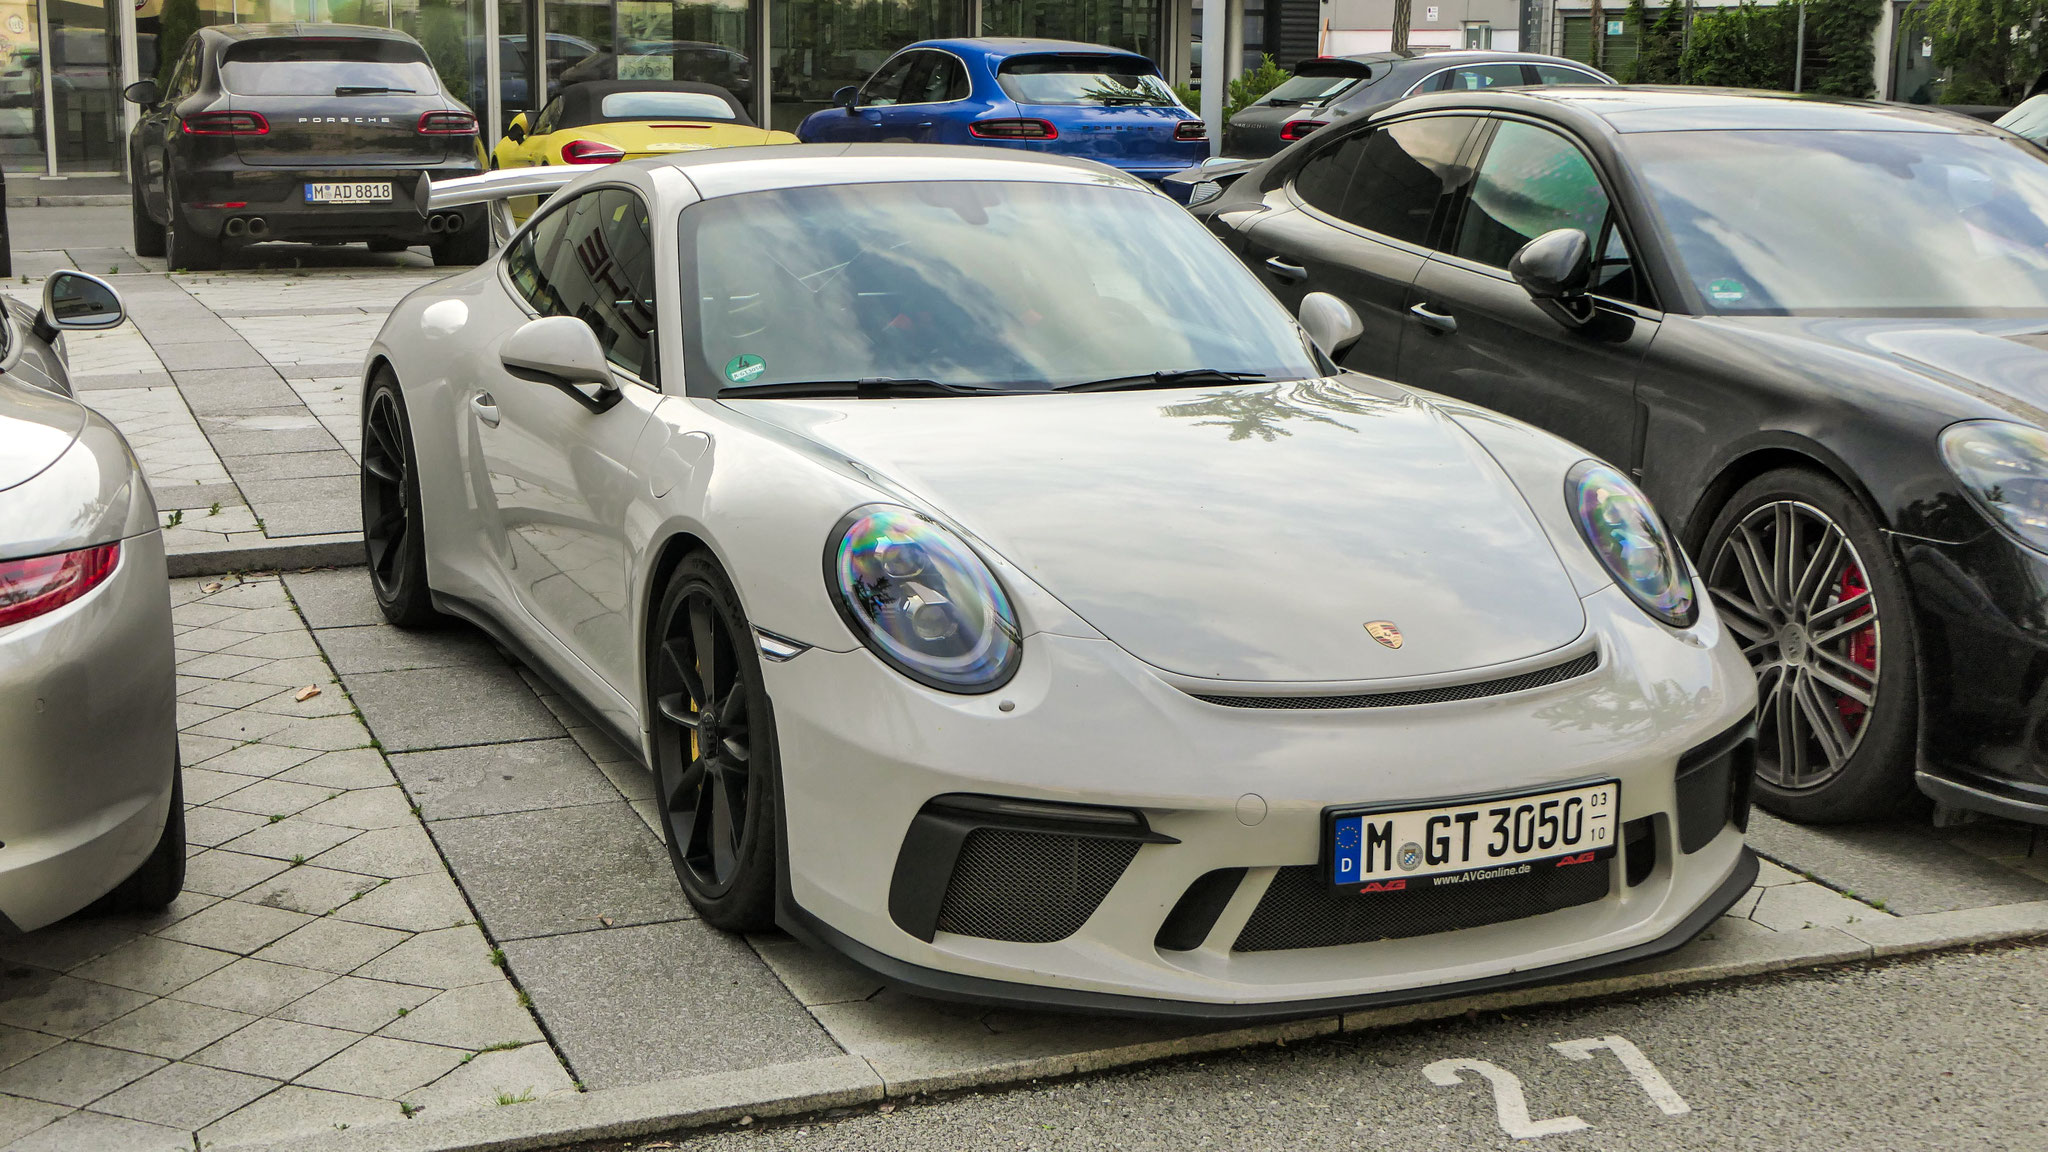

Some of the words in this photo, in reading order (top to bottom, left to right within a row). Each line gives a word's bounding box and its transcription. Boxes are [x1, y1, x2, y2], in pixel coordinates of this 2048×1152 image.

[314, 185, 324, 199] M
[334, 185, 352, 199] AD
[355, 184, 390, 198] 8818
[1591, 792, 1607, 807] 03
[1341, 857, 1352, 873] D
[1366, 820, 1393, 874] M
[1425, 811, 1479, 866] GT
[1488, 796, 1583, 858] 3050
[1591, 826, 1605, 841] 10
[1555, 851, 1595, 867] AVG
[1433, 863, 1531, 886] www.AVGonline.de
[1360, 879, 1406, 894] AVG
[1421, 1034, 1692, 1140] 27
